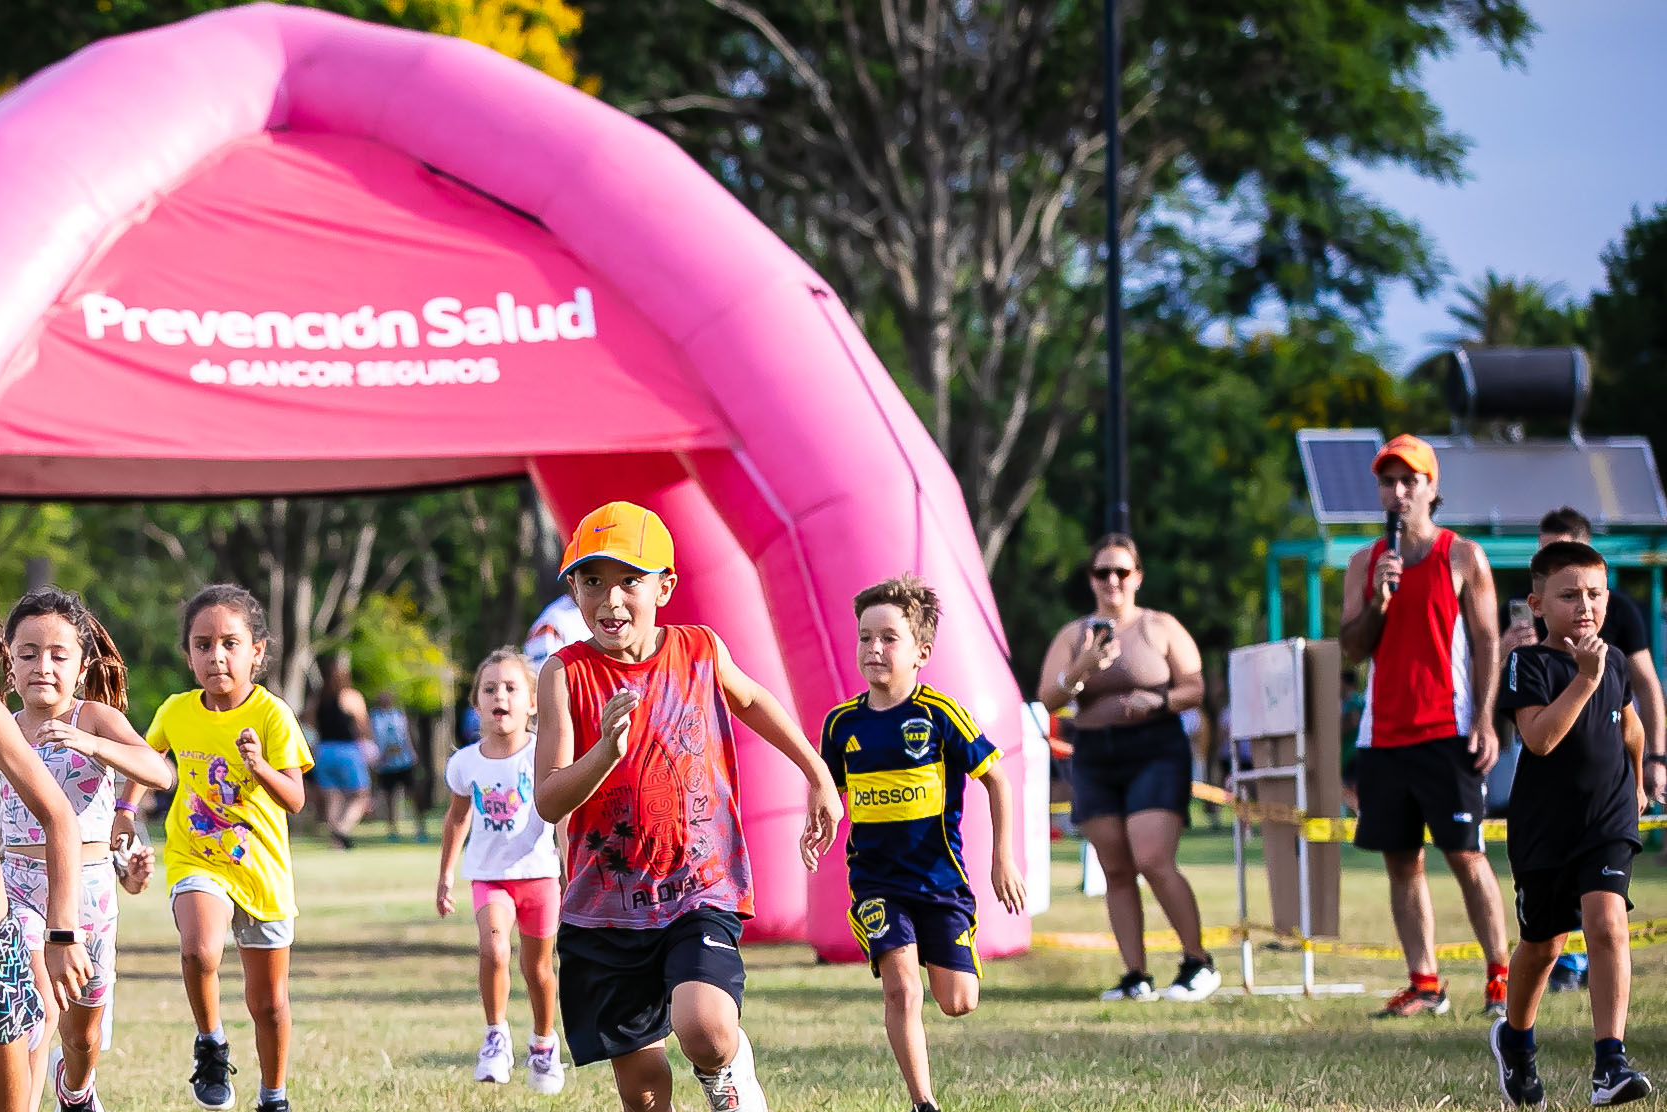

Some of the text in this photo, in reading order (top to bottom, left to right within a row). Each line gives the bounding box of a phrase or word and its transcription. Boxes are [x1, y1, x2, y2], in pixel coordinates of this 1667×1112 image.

[82, 286, 597, 349] Prevención Salud
[228, 359, 354, 387] SANCOR
[355, 357, 500, 386] SEGUROS
[854, 785, 926, 807] betsson
[484, 817, 515, 832] PWR
